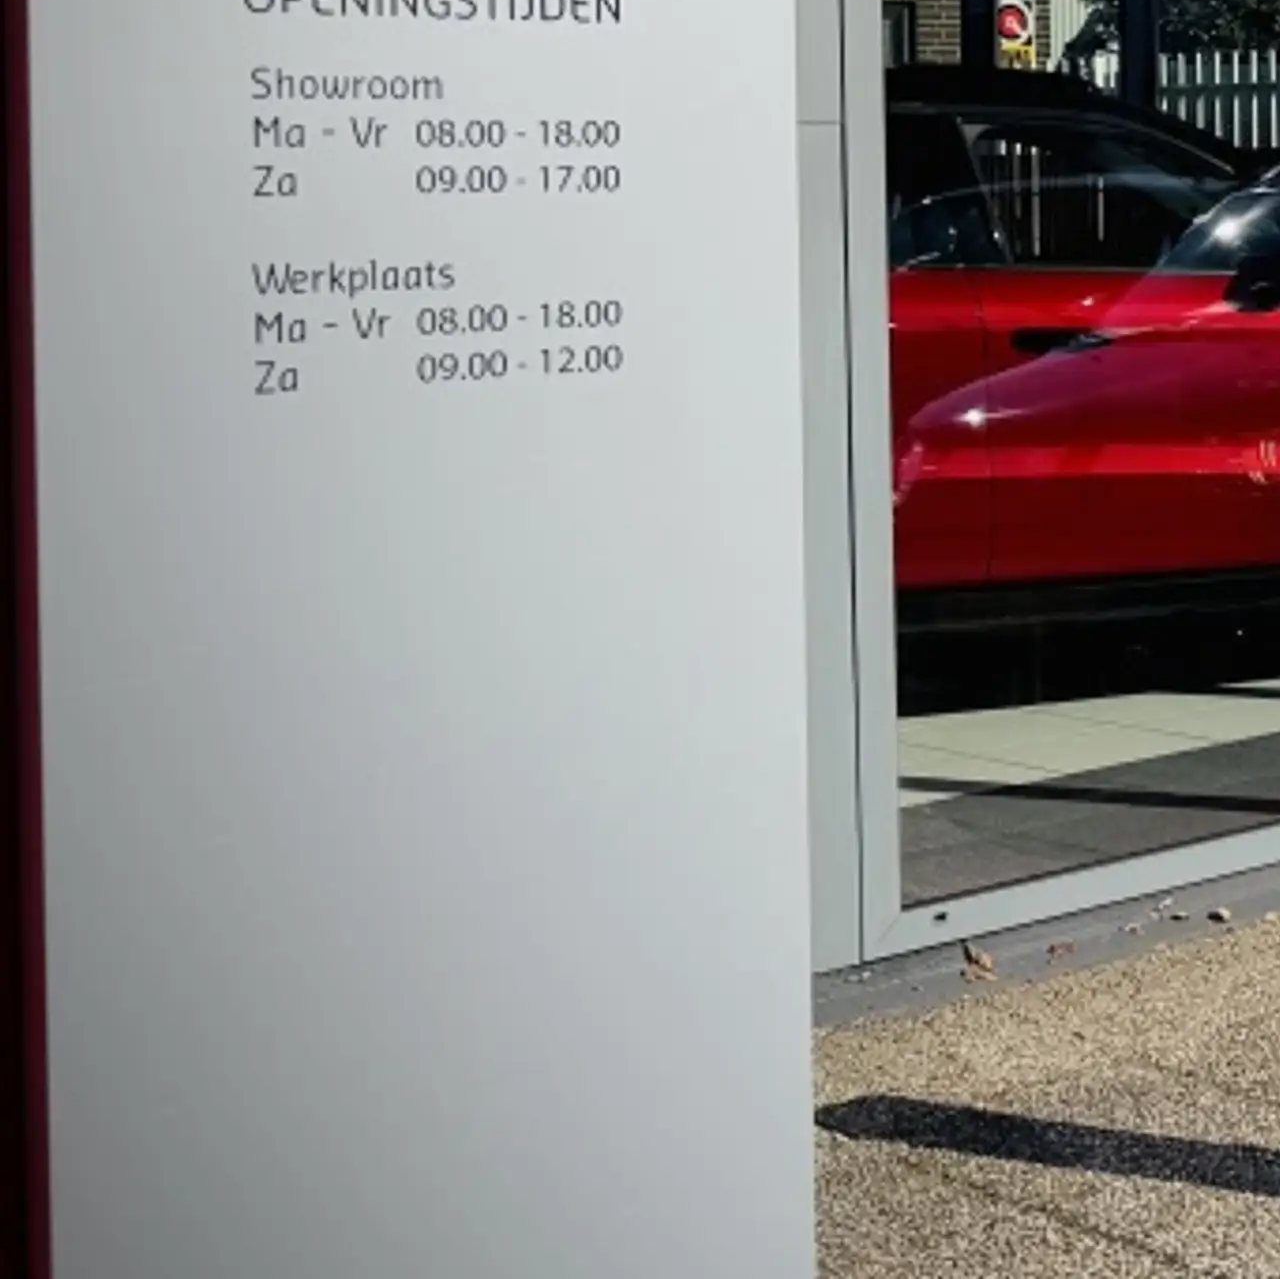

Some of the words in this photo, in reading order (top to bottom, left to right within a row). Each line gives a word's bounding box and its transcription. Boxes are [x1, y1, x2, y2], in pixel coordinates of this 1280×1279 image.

[250, 66, 444, 102] Showroom
[252, 115, 306, 149] Ma
[349, 116, 389, 148] Vr
[414, 119, 507, 149] 08.00
[537, 120, 622, 149] 18.00
[252, 165, 298, 197] Za
[414, 165, 507, 195] 09.00
[538, 164, 622, 194] 17.00
[251, 259, 457, 299] Werkplaats
[254, 311, 307, 344] Ma
[351, 307, 393, 340] Vr
[415, 305, 508, 336] 08.00
[539, 301, 624, 329] 18.00
[254, 360, 299, 395] Za
[415, 351, 508, 384] 09.00
[539, 344, 624, 375] 12.00
